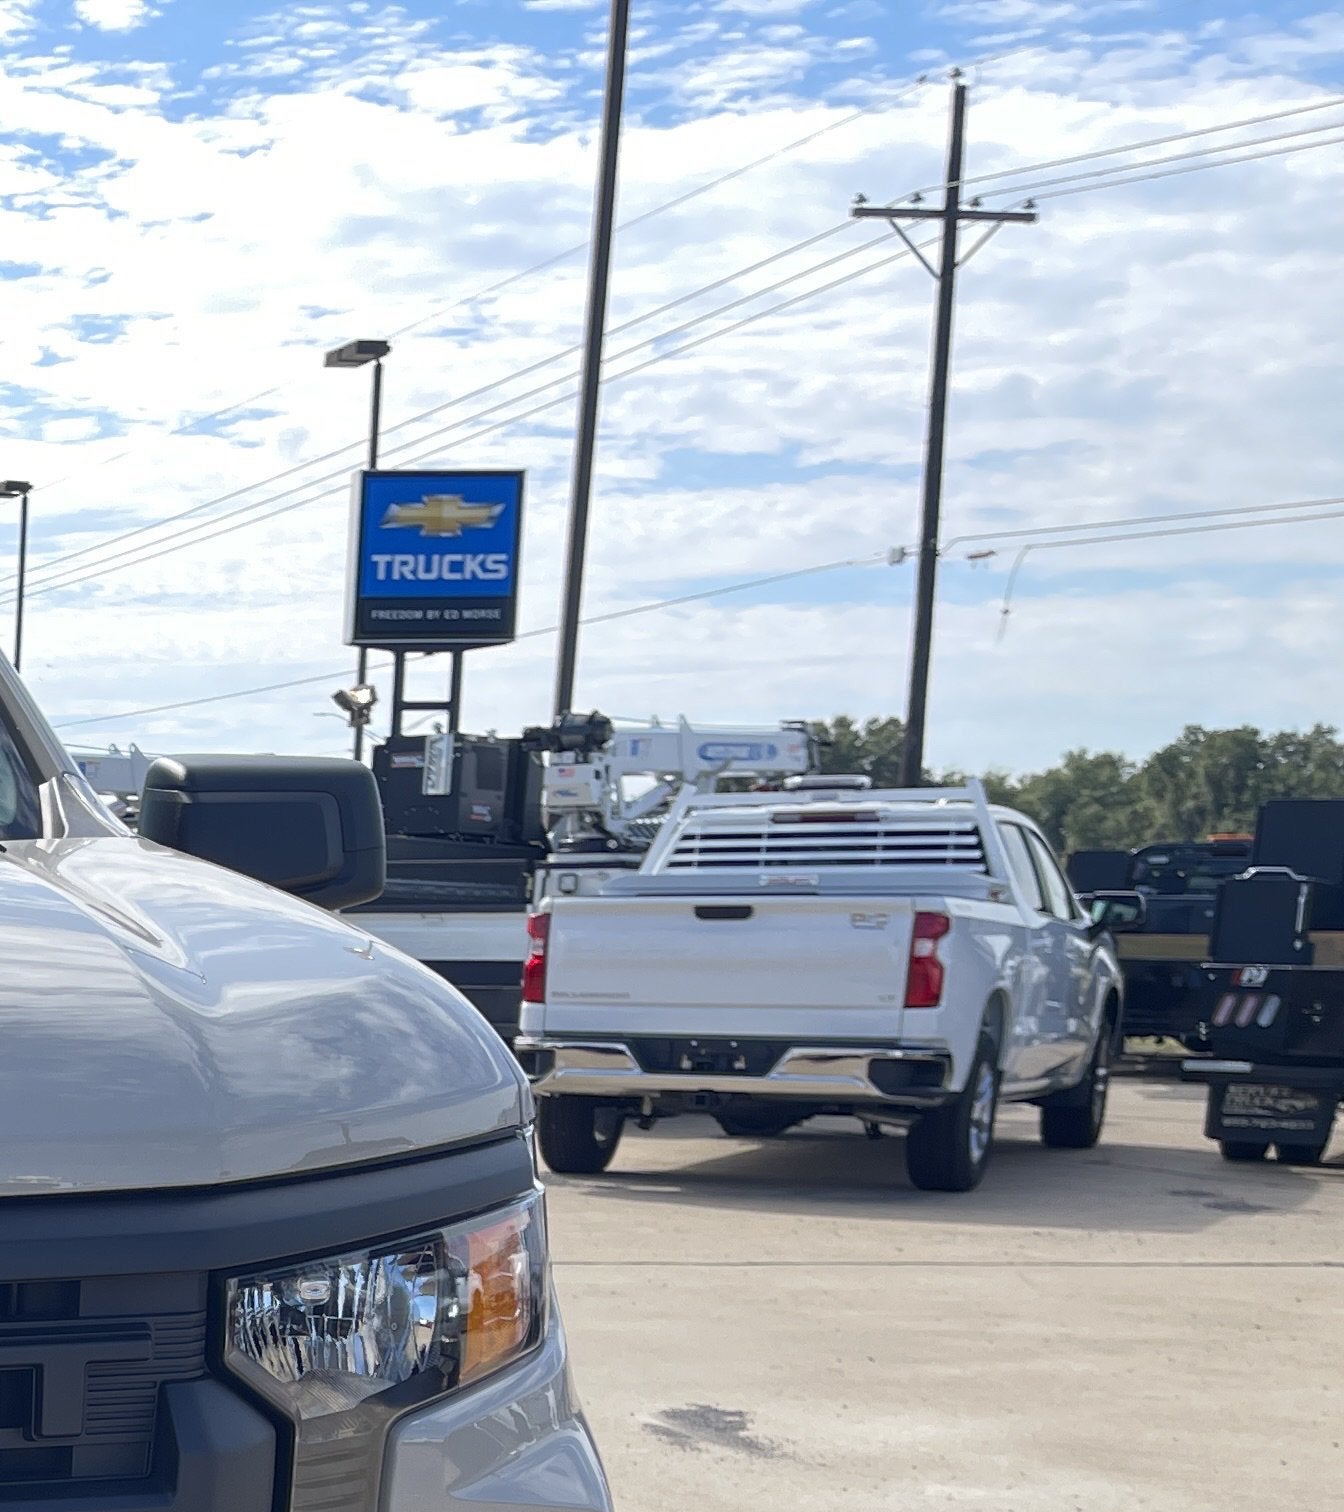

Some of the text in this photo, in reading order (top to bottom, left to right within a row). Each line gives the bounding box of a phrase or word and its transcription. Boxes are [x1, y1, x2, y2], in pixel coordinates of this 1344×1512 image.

[370, 554, 509, 580] TRUCKS
[371, 608, 502, 620] FREEDOM BY ED MORSE
